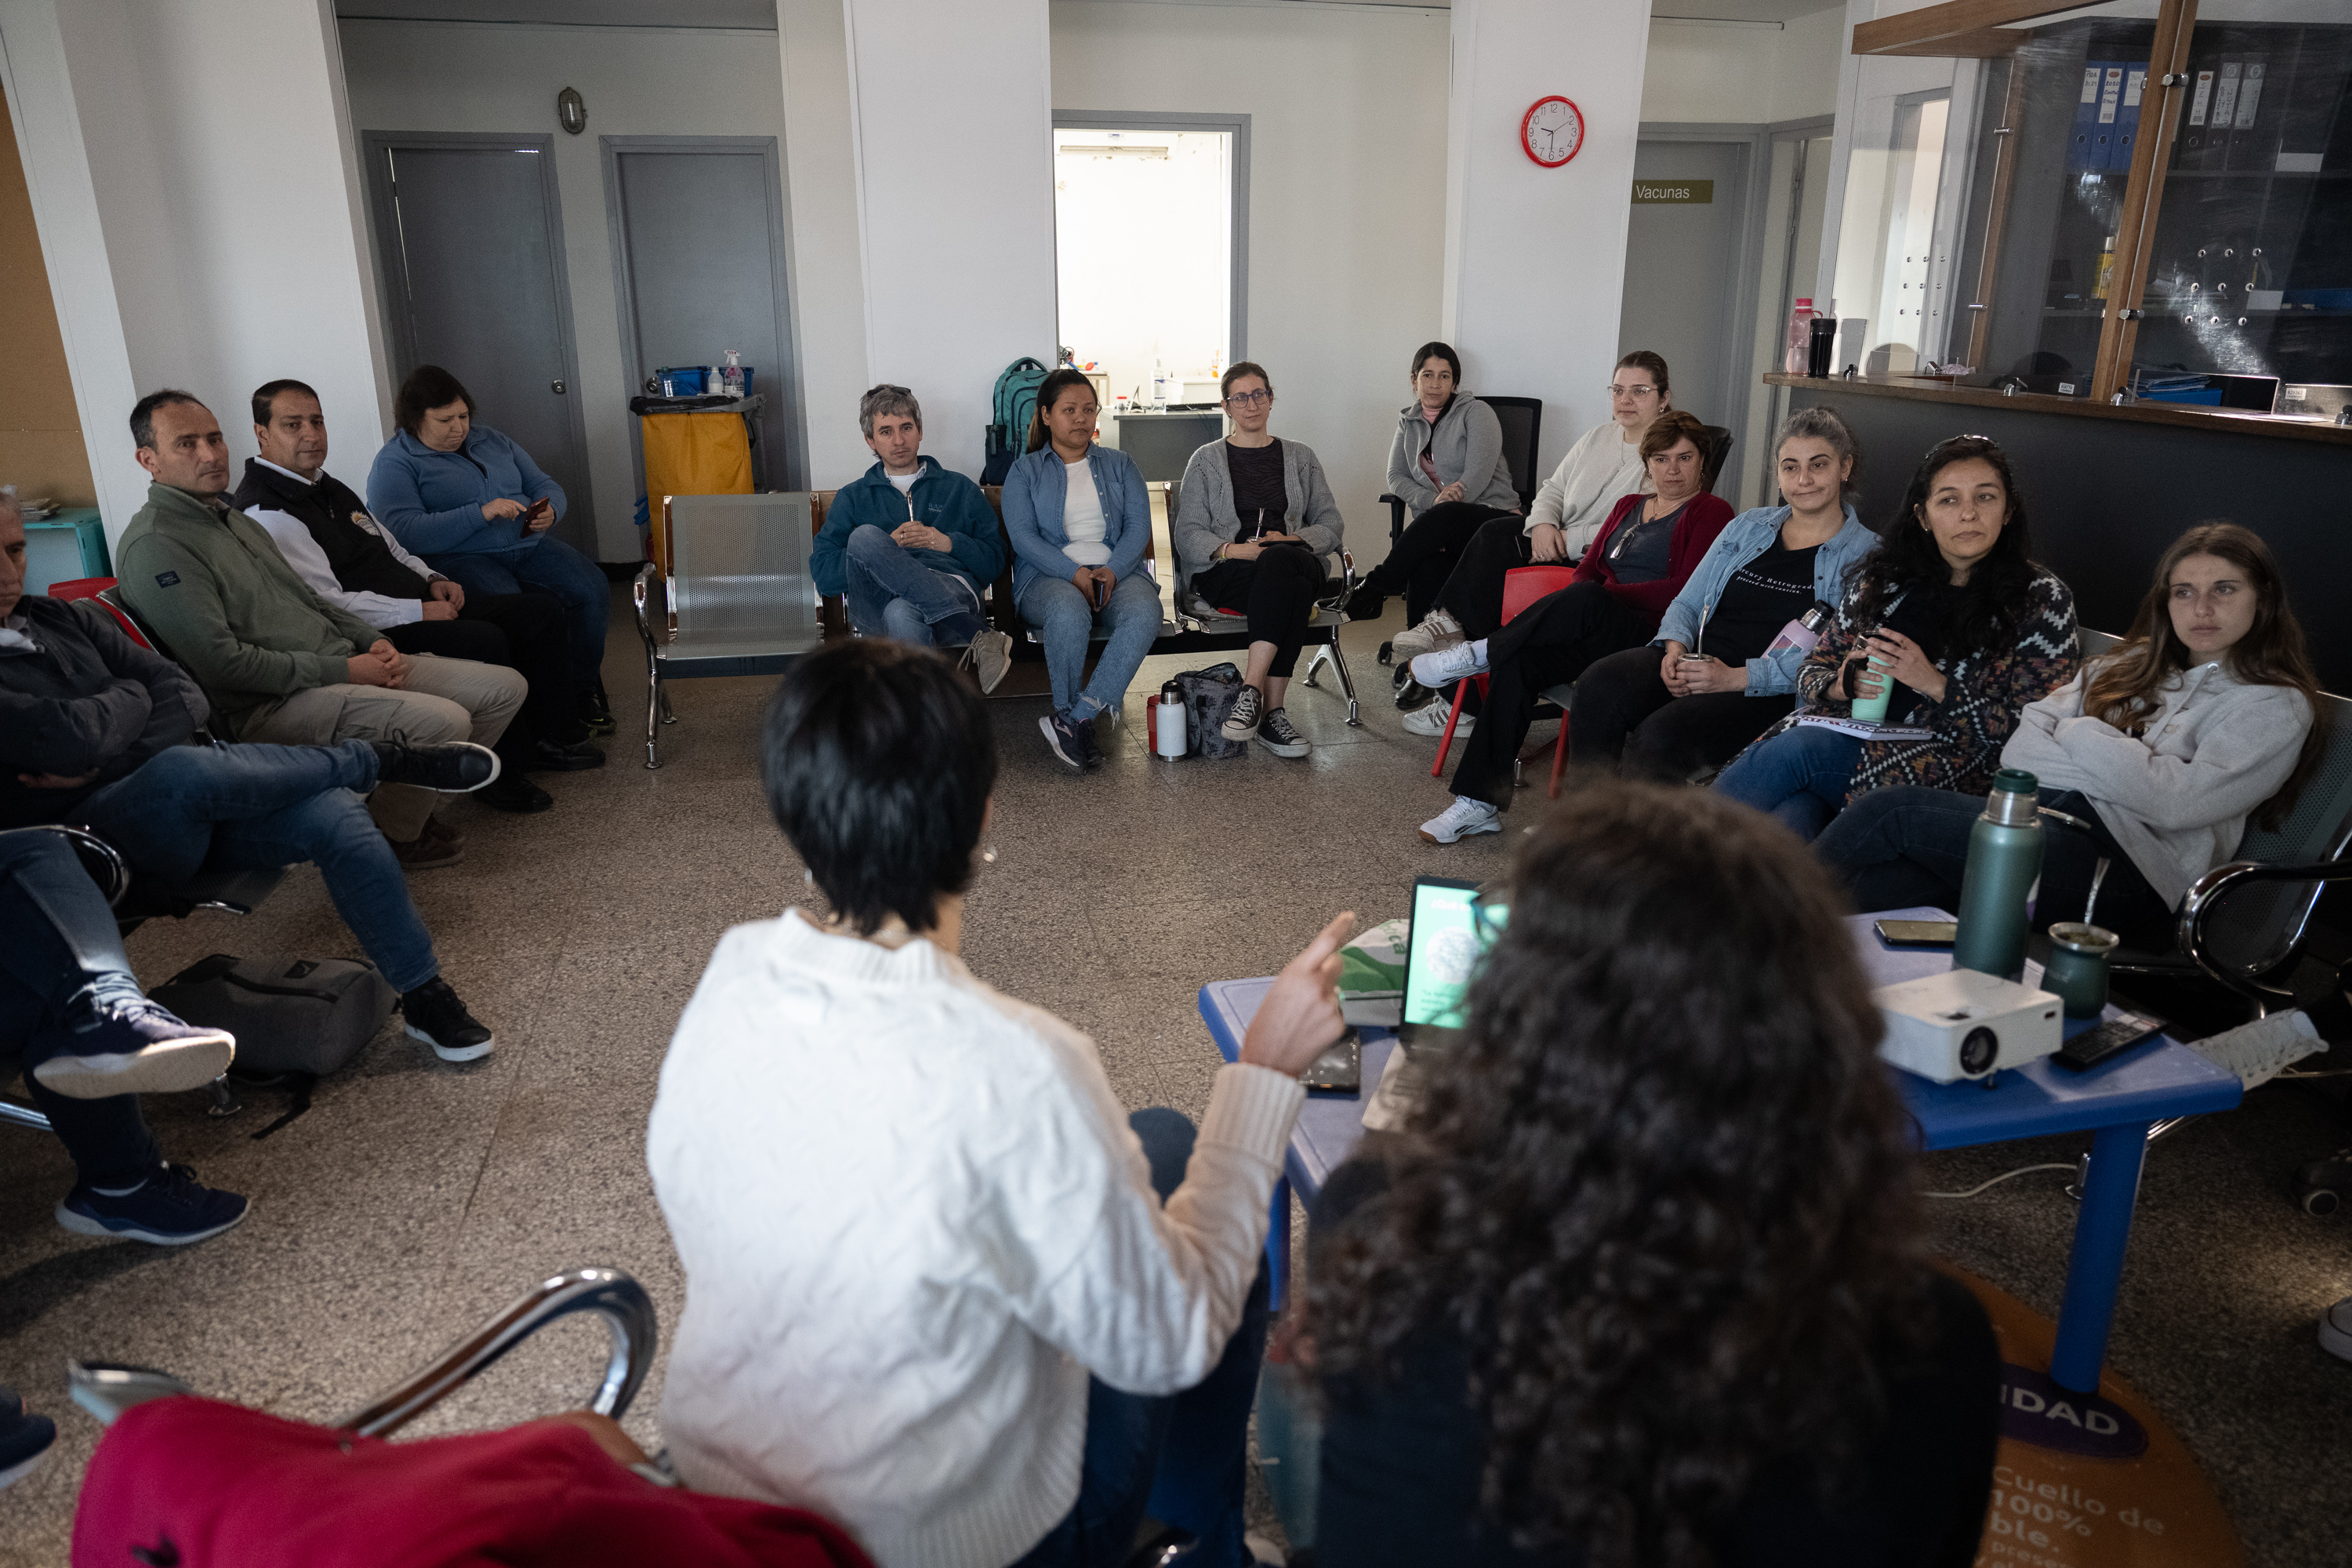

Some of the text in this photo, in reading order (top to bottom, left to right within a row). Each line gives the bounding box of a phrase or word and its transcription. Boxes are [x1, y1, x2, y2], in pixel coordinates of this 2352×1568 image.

[1541, 107, 1546, 115] 11
[1551, 103, 1558, 113] 12
[1563, 107, 1566, 115] 1
[1532, 115, 1540, 125] 10
[1569, 115, 1574, 125] 2
[1529, 127, 1534, 137] 9
[1571, 127, 1577, 137] 3
[1531, 140, 1537, 149] 8
[1567, 140, 1573, 148] 4
[1539, 147, 1544, 157] 7
[1548, 151, 1555, 161] 6
[1559, 147, 1564, 157] 5
[1635, 185, 1690, 199] Vacunas
[1993, 1466, 2165, 1535] Cuello de
[1991, 1489, 2092, 1537] 100%
[1991, 1511, 2061, 1552] ble.
